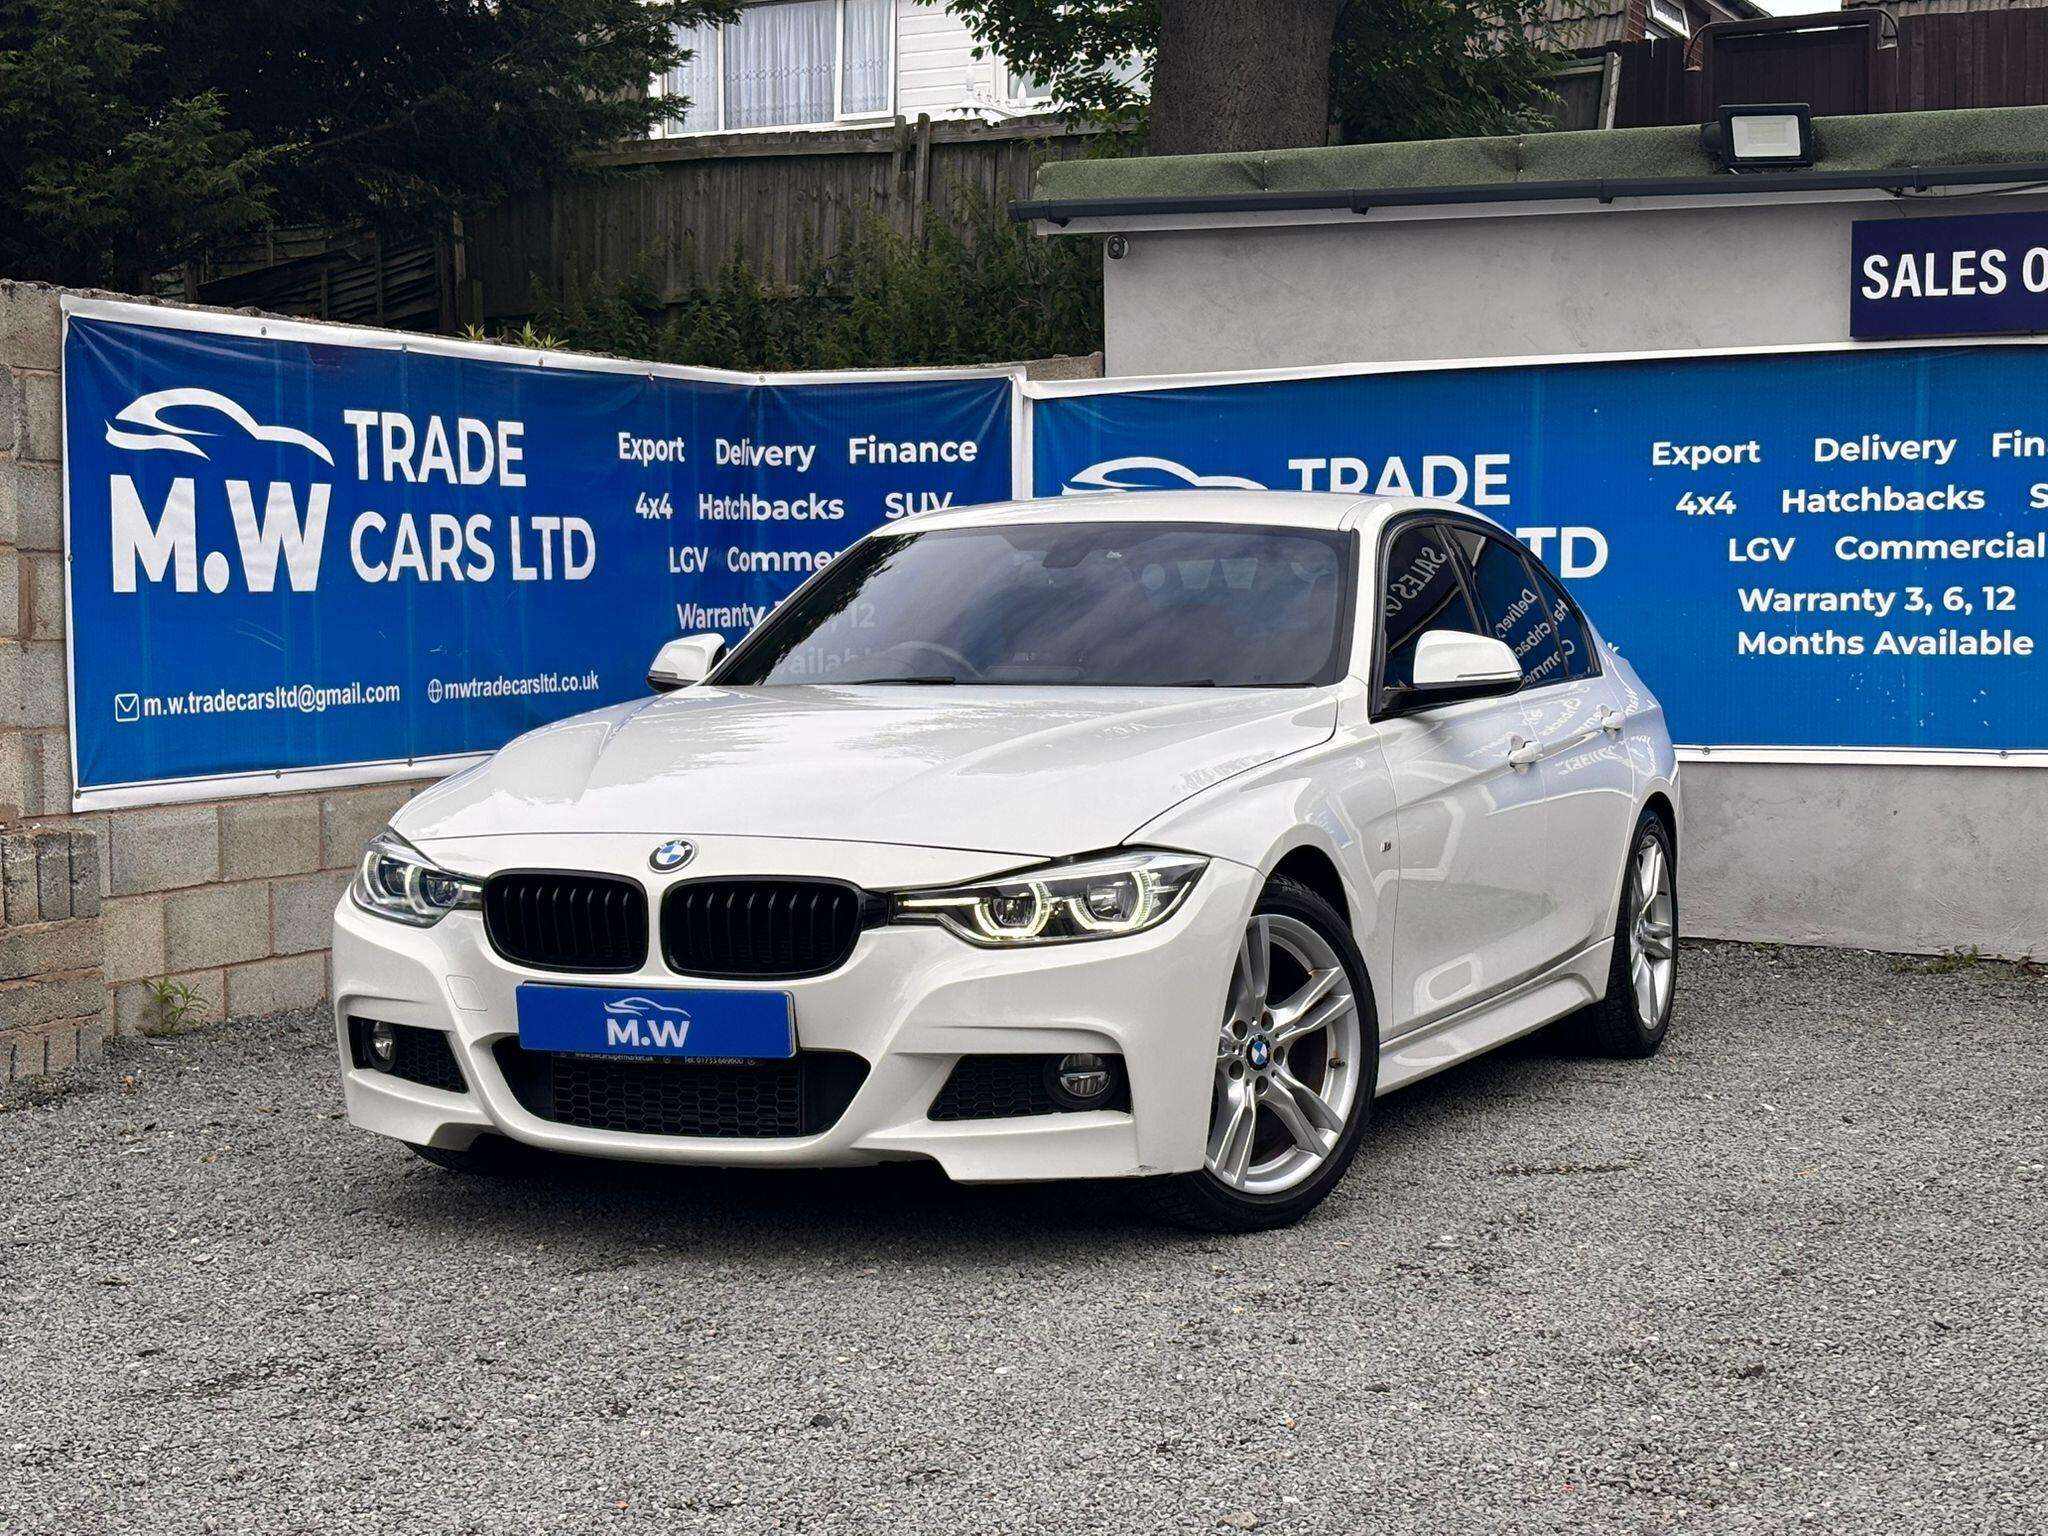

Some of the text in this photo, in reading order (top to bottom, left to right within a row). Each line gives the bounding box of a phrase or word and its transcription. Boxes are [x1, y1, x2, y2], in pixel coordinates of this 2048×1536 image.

[1862, 249, 2007, 300] SALES
[344, 410, 527, 487] TRADE
[618, 432, 978, 473] Export Delivery Finance
[1652, 440, 1761, 471] Export
[1814, 433, 1958, 465] Delivery
[1288, 454, 1511, 506] TRADE
[635, 491, 954, 521] 4x4 Hatchbacks SUV
[1675, 490, 1737, 516] 4x4
[1782, 484, 1986, 514] Hatchbacks
[111, 475, 332, 593] M.W
[351, 511, 596, 583] CARS LTD
[1728, 530, 2046, 562] LGV Commercial
[670, 546, 709, 574] LGV
[676, 602, 766, 631] Warranty
[1738, 586, 2016, 617] Warranty 3, 6, 12
[1738, 628, 2034, 656] Months Available
[144, 682, 400, 717] m.w.tradecarsltd@gmail.com
[444, 670, 599, 699] mwtradecarsltd.co.uk
[606, 1018, 690, 1048] M.W
